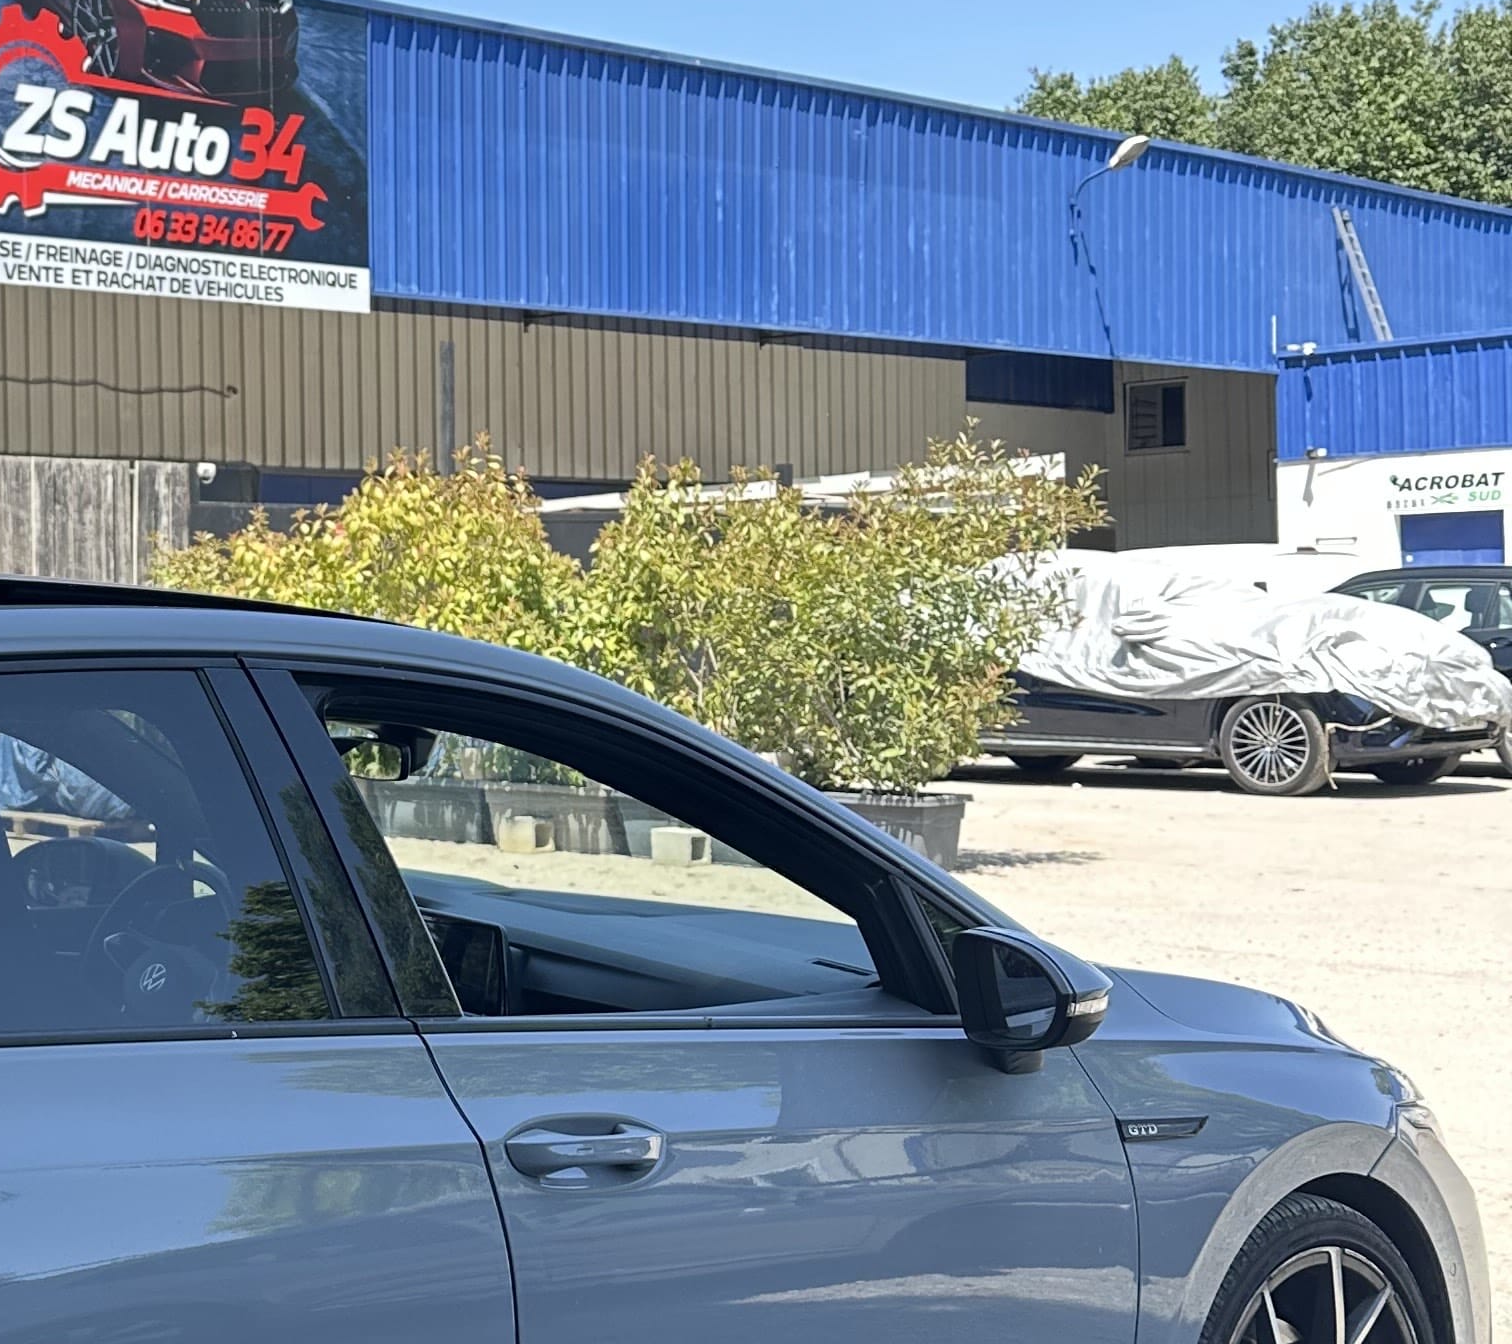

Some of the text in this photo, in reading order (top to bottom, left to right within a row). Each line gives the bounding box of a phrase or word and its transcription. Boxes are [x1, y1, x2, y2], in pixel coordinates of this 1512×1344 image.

[3, 83, 306, 184] ZS Auto 34
[66, 170, 160, 198] MECANIQUE
[168, 182, 270, 210] CARROSSERIE
[133, 207, 295, 253] 06 33 34 86 77
[3, 262, 285, 303] VENTE ET RACHAT DE VEHICULES
[34, 243, 124, 268] FREINAGE
[135, 252, 237, 279] DIAGNOSTIC
[240, 263, 358, 290] ELECTRONIQUE
[1398, 472, 1505, 493] ACROBAT
[1468, 490, 1502, 502] SUD
[1128, 1123, 1158, 1136] GTD
